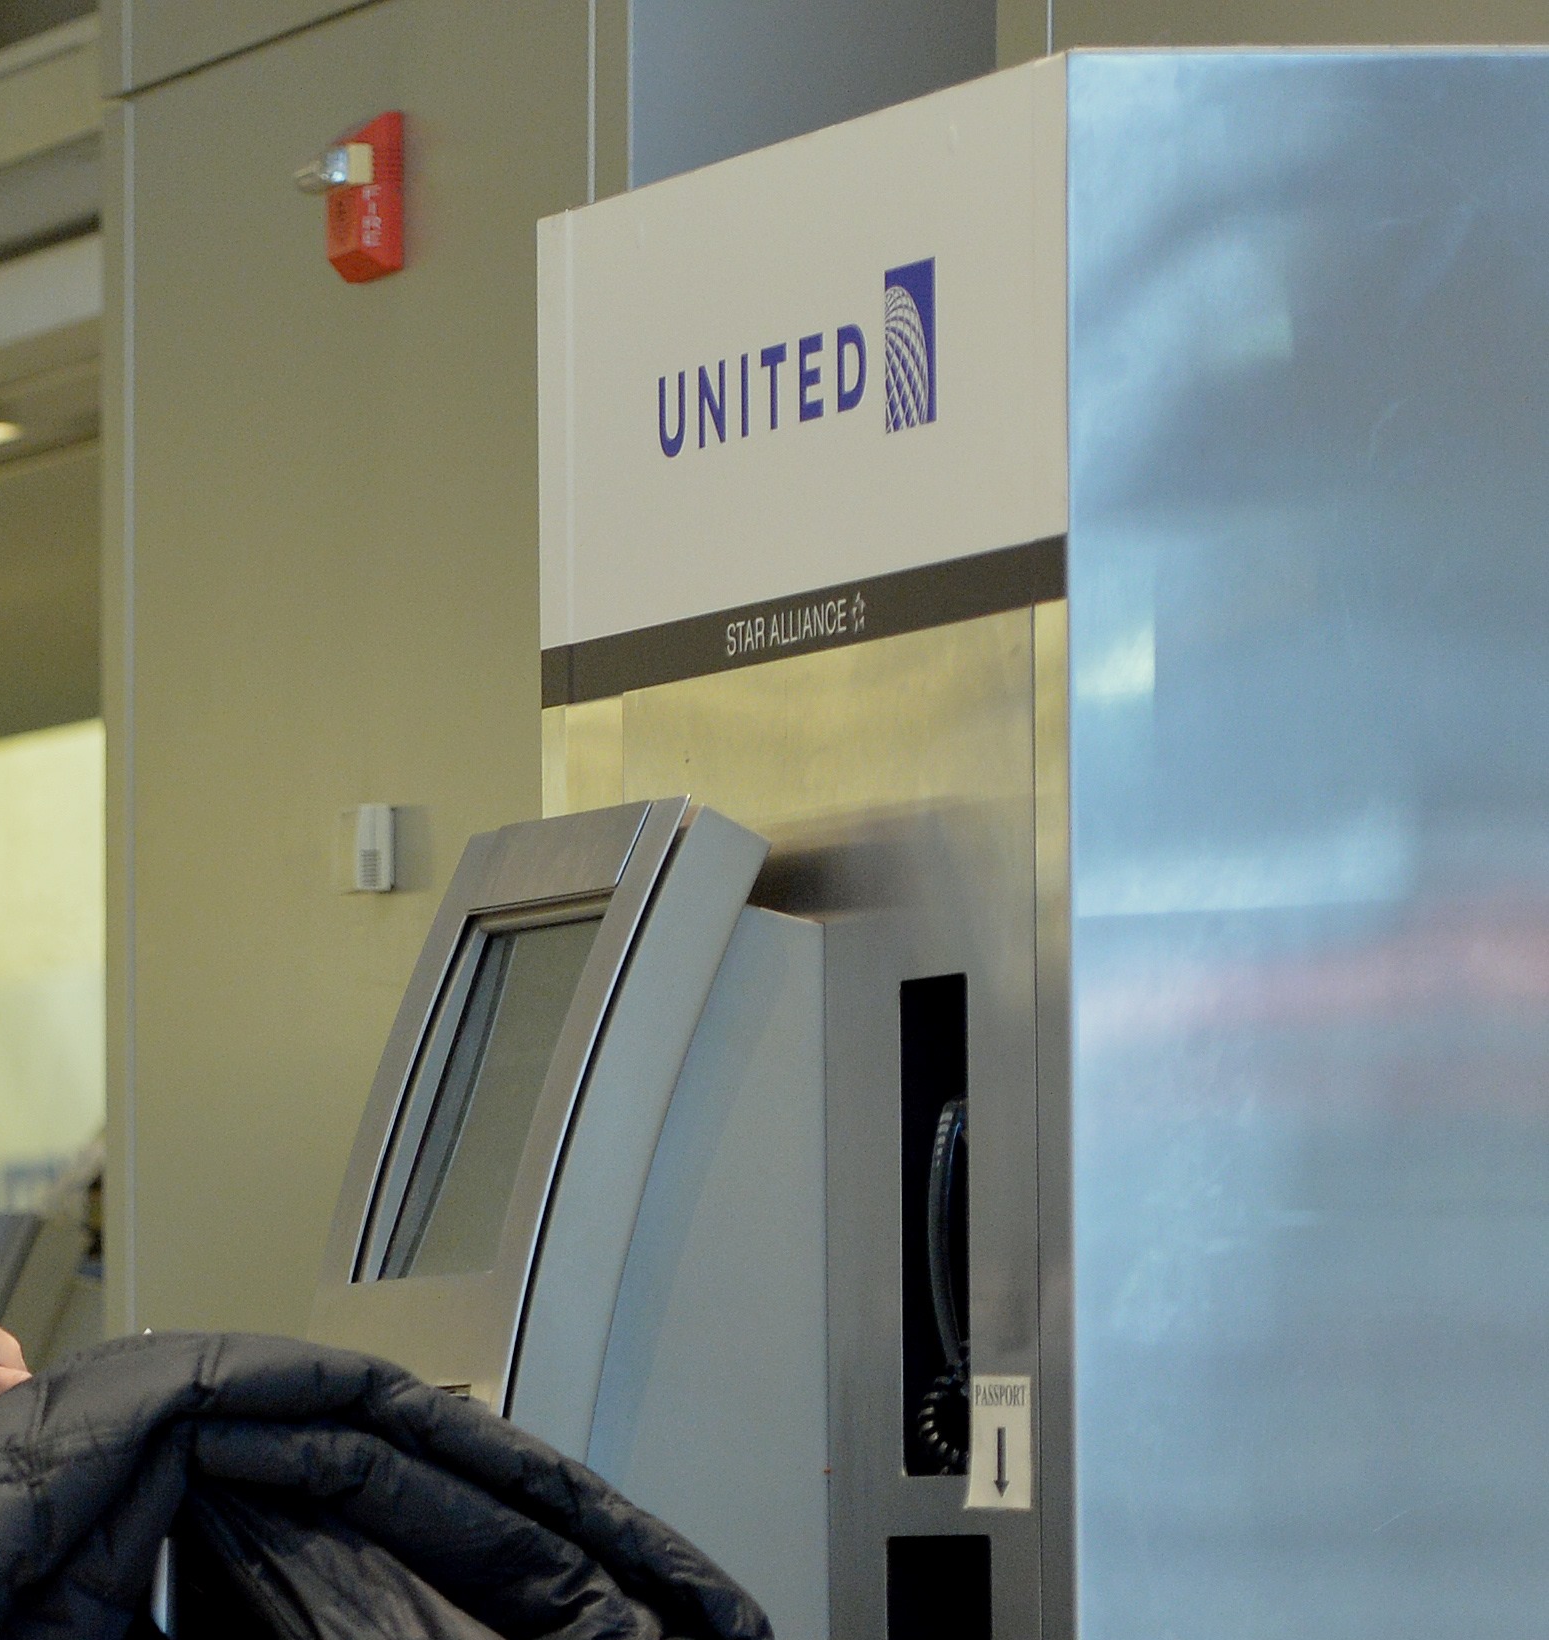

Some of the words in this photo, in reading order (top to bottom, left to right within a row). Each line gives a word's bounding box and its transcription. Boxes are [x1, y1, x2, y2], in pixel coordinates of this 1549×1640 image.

[657, 322, 868, 459] UNITED
[725, 614, 766, 657] STAR
[769, 599, 847, 646] ALLIANCE
[974, 1383, 1026, 1407] PASSPORT
